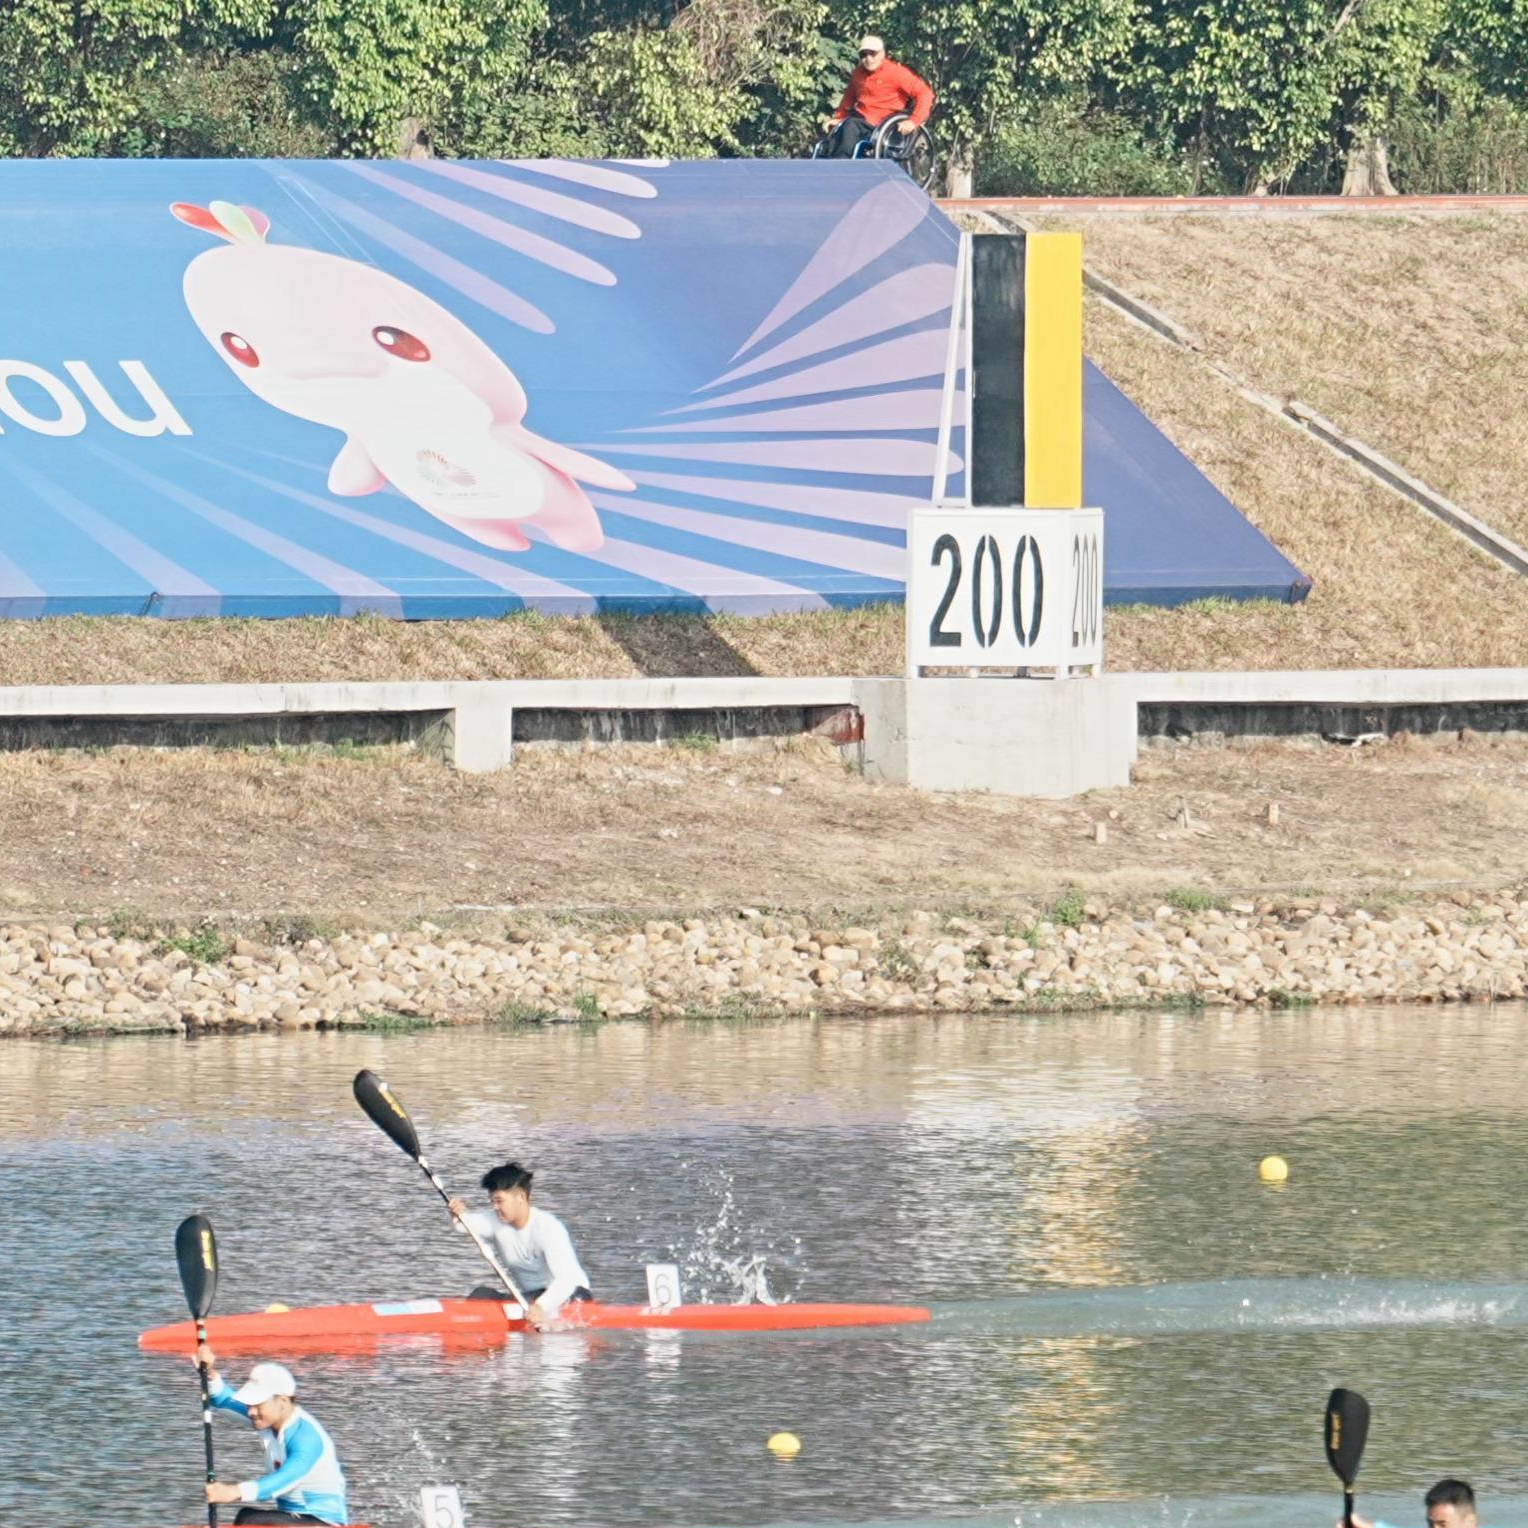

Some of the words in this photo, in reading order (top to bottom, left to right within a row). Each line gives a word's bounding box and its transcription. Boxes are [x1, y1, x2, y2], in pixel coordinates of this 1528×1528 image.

[930, 533, 1044, 648] 200
[1072, 534, 1098, 648] 200
[655, 1273, 672, 1305] 6
